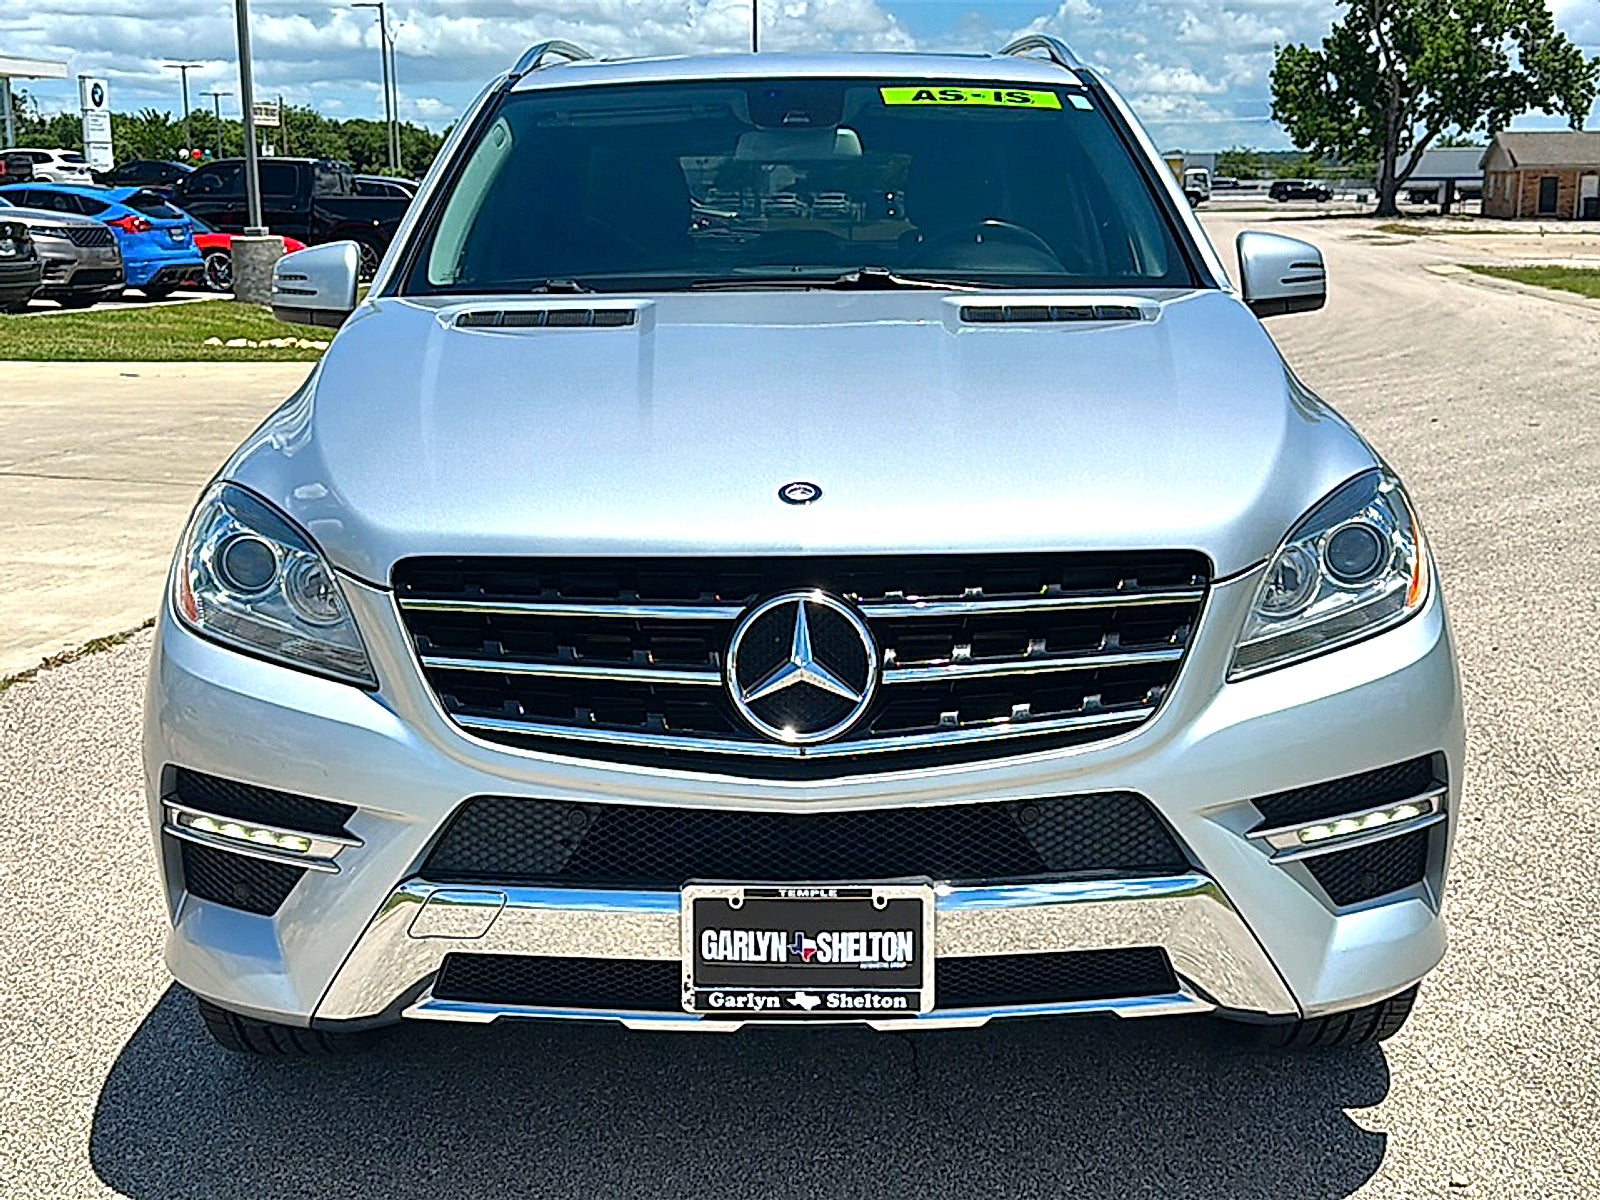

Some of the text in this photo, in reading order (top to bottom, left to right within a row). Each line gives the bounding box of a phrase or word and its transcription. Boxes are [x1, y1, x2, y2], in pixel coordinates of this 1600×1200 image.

[778, 889, 837, 898] TEMPLE
[701, 930, 913, 962] GARLYN SHELTON
[708, 992, 907, 1010] Garlyn Shelton
